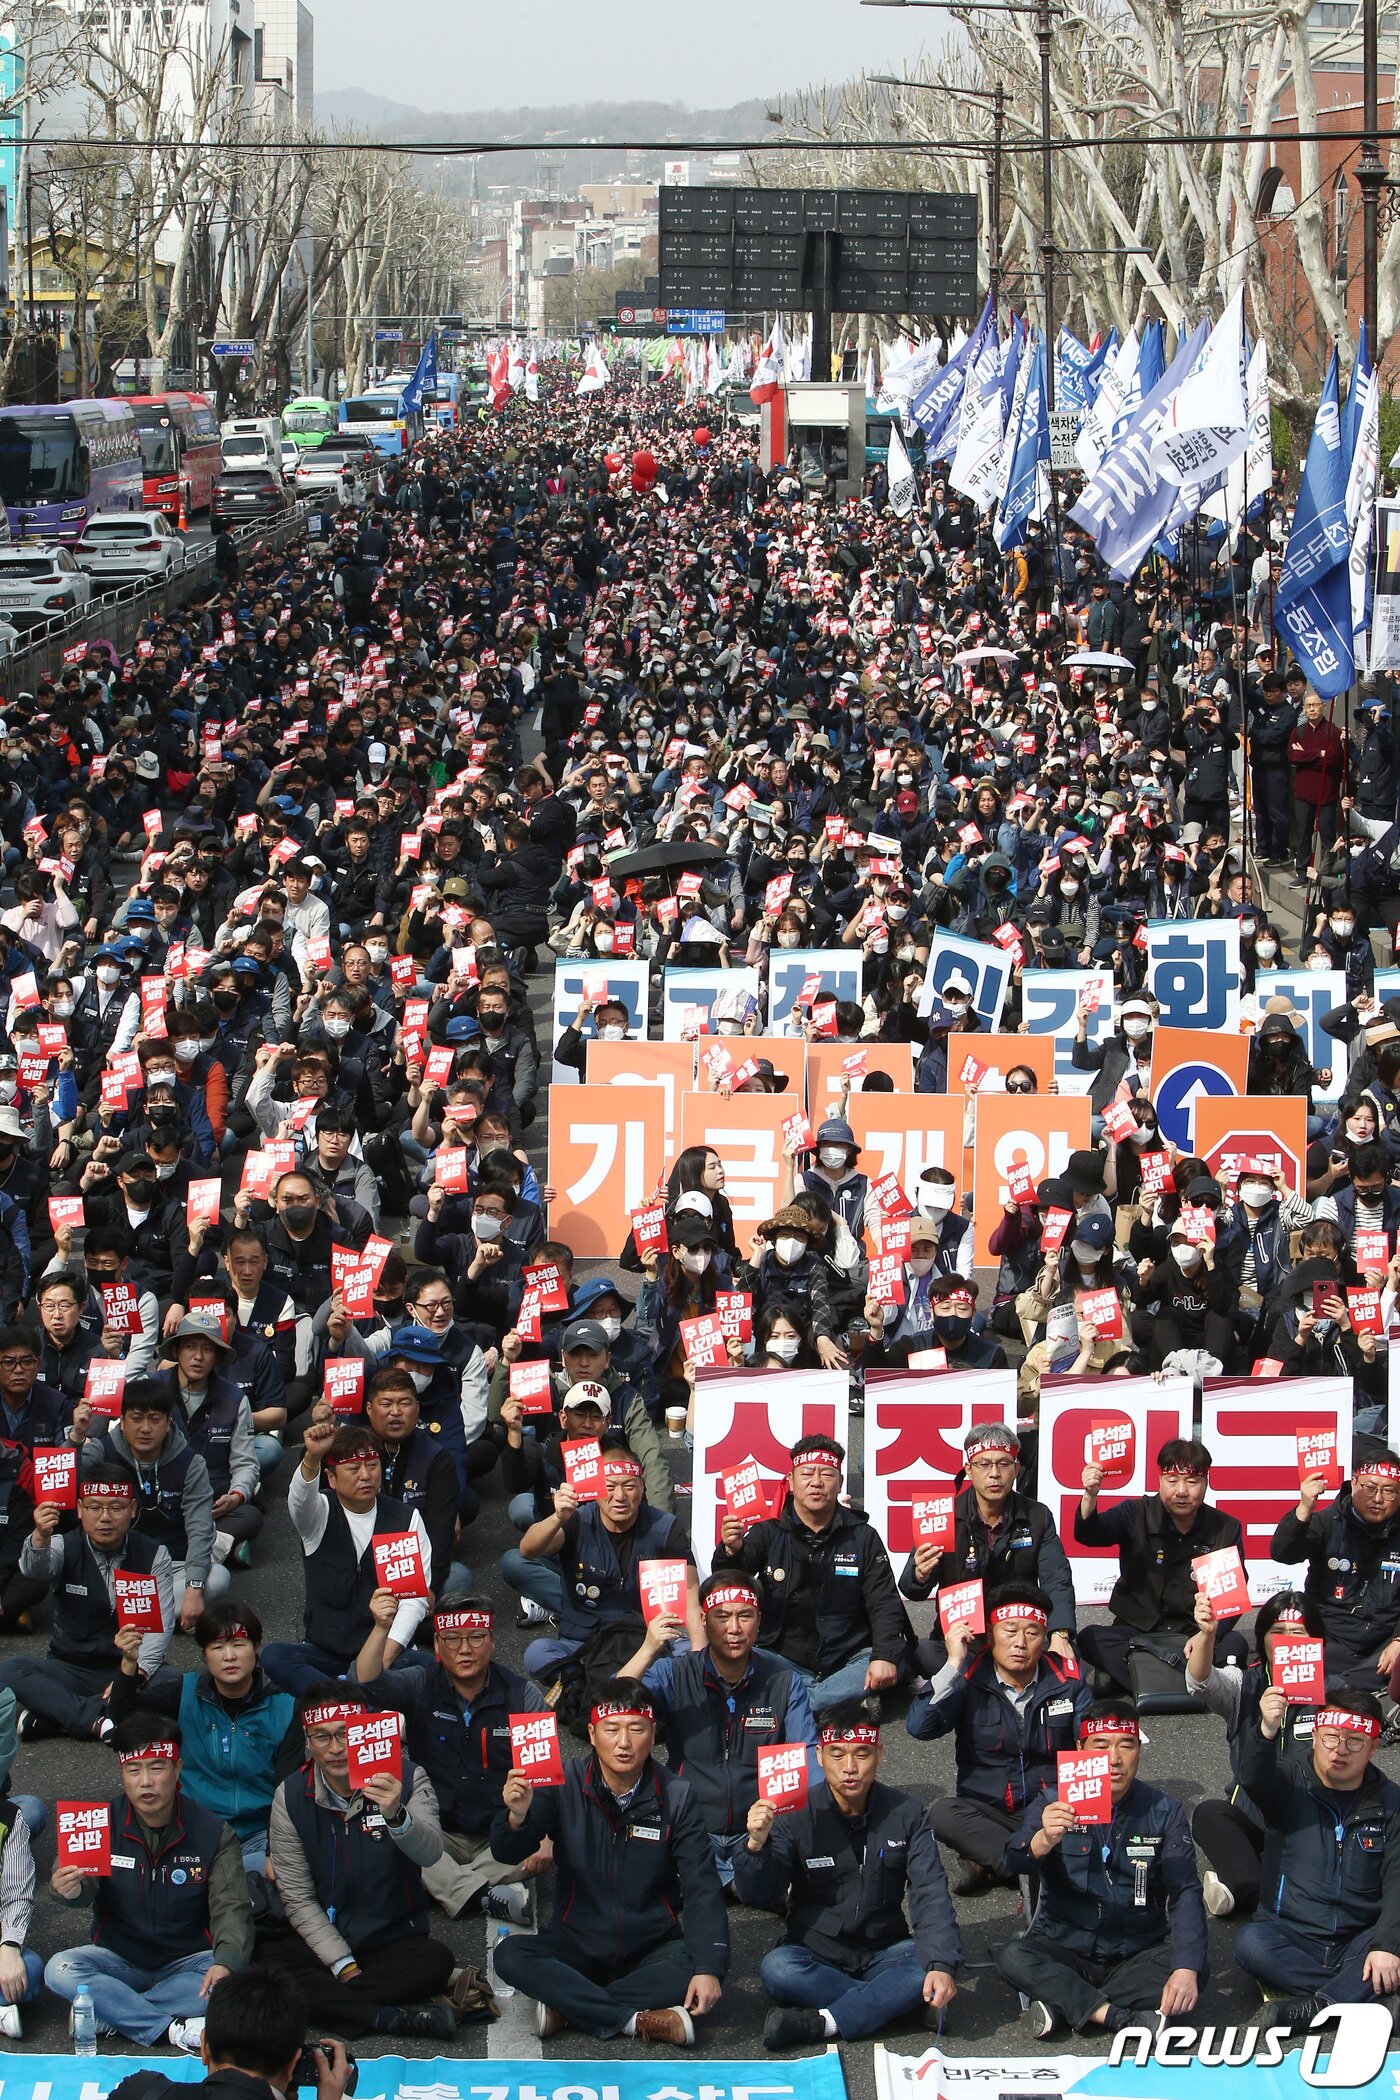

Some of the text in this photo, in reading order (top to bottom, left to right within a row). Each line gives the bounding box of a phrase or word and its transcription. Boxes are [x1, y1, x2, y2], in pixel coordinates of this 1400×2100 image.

[380, 407, 394, 415] 273
[615, 926, 634, 937] 윤석열
[617, 934, 632, 944] 심판
[392, 957, 413, 970] 윤석열
[396, 967, 412, 979] 심판
[142, 979, 165, 990] 윤석열
[1151, 935, 1239, 1030] 화
[145, 988, 163, 1000] 심판
[404, 1004, 428, 1017] 윤석열
[408, 1015, 424, 1026] 심판
[38, 1025, 66, 1038] 윤석열
[44, 1034, 63, 1044] 심판
[403, 1033, 418, 1050] 윤석열
[405, 1043, 420, 1057] 심판
[20, 1058, 50, 1071] 윤석열
[428, 1052, 455, 1065] 윤석열
[428, 1061, 446, 1073] 심판
[22, 1069, 43, 1081] 심판
[102, 1073, 125, 1088] 윤석열
[105, 1086, 123, 1098] 심판
[436, 1151, 466, 1169] 윤석열
[566, 1121, 646, 1216] 기
[1141, 1154, 1163, 1169] 주 69
[441, 1166, 462, 1182] 심판
[1007, 1167, 1029, 1185] 윤석열
[1144, 1166, 1170, 1180] 시간제
[875, 1175, 898, 1197] 윤석열
[1012, 1181, 1030, 1195] 심판
[882, 1189, 900, 1209] 심판
[633, 1206, 664, 1230] 윤석열
[639, 1221, 662, 1239] 심판
[882, 1221, 911, 1237] 윤석열
[886, 1234, 907, 1250] 심판
[1357, 1234, 1388, 1248] 윤석열
[332, 1252, 359, 1266] 윤석열
[1362, 1246, 1383, 1259] 심판
[869, 1258, 895, 1274] 주 69
[343, 1268, 373, 1288] 윤석열
[526, 1267, 558, 1285] 윤석열
[871, 1269, 902, 1288] 시간제
[104, 1287, 128, 1301] 주 69
[347, 1285, 368, 1301] 심판
[716, 1294, 745, 1308] 주 69
[1347, 1291, 1379, 1308] 윤석열
[106, 1300, 137, 1316] 시간제
[1081, 1290, 1116, 1316] 윤석열
[719, 1308, 751, 1322] 시간제
[1092, 1307, 1115, 1325] 심판
[1354, 1306, 1376, 1321] 심판
[684, 1319, 713, 1340] 주 69
[687, 1333, 724, 1355] 시간제
[88, 1364, 127, 1381] 윤석열
[326, 1362, 363, 1382] 윤석열
[511, 1363, 550, 1384] 윤석열
[91, 1380, 119, 1397] 심판
[331, 1380, 358, 1397] 심판
[518, 1380, 544, 1398] 심판
[1091, 1423, 1132, 1446] 윤석열
[1297, 1431, 1336, 1454] 윤석열
[564, 1441, 602, 1468] 윤석열
[793, 1452, 839, 1467] 단결 투쟁
[1098, 1443, 1127, 1461] 심판
[1304, 1450, 1331, 1469] 심판
[35, 1452, 75, 1476] 윤석열
[572, 1460, 599, 1483] 심판
[41, 1470, 71, 1491] 심판
[724, 1465, 759, 1495] 윤석열
[83, 1483, 129, 1496] 단결 투쟁
[732, 1486, 757, 1509] 심판
[913, 1497, 954, 1520] 윤석열
[920, 1516, 948, 1535] 심판
[375, 1535, 419, 1565] 윤석열
[384, 1557, 416, 1582] 심판
[640, 1563, 686, 1589] 윤석열
[115, 1579, 157, 1598] 윤석열
[1208, 1571, 1238, 1599] 심판
[648, 1585, 679, 1608] 심판
[706, 1591, 725, 1609] 단결
[940, 1583, 982, 1610] 윤석열
[122, 1597, 152, 1615] 심판
[947, 1600, 977, 1623] 심판
[997, 1605, 1018, 1621] 단결
[438, 1612, 490, 1630] 단결 투쟁
[1274, 1642, 1322, 1665] 윤석열
[1281, 1664, 1316, 1685] 심판
[304, 1707, 323, 1725] 단결
[1316, 1710, 1333, 1727] 단결
[1350, 1714, 1373, 1734] 투쟁
[347, 1716, 399, 1748] 윤석열
[511, 1716, 556, 1747] 윤석열
[856, 1728, 878, 1743] 투쟁
[1086, 1719, 1137, 1734] 단결 투쟁
[151, 1742, 174, 1758] 투쟁
[357, 1740, 393, 1765] 심판
[519, 1740, 551, 1766] 심판
[759, 1748, 806, 1779] 윤석열
[1058, 1754, 1109, 1784] 윤석열
[766, 1770, 801, 1797] 심판
[1067, 1778, 1103, 1803] 심판
[58, 1807, 109, 1833] 윤석열
[67, 1830, 103, 1855] 심판
[943, 2066, 1061, 2082] 민주노총
